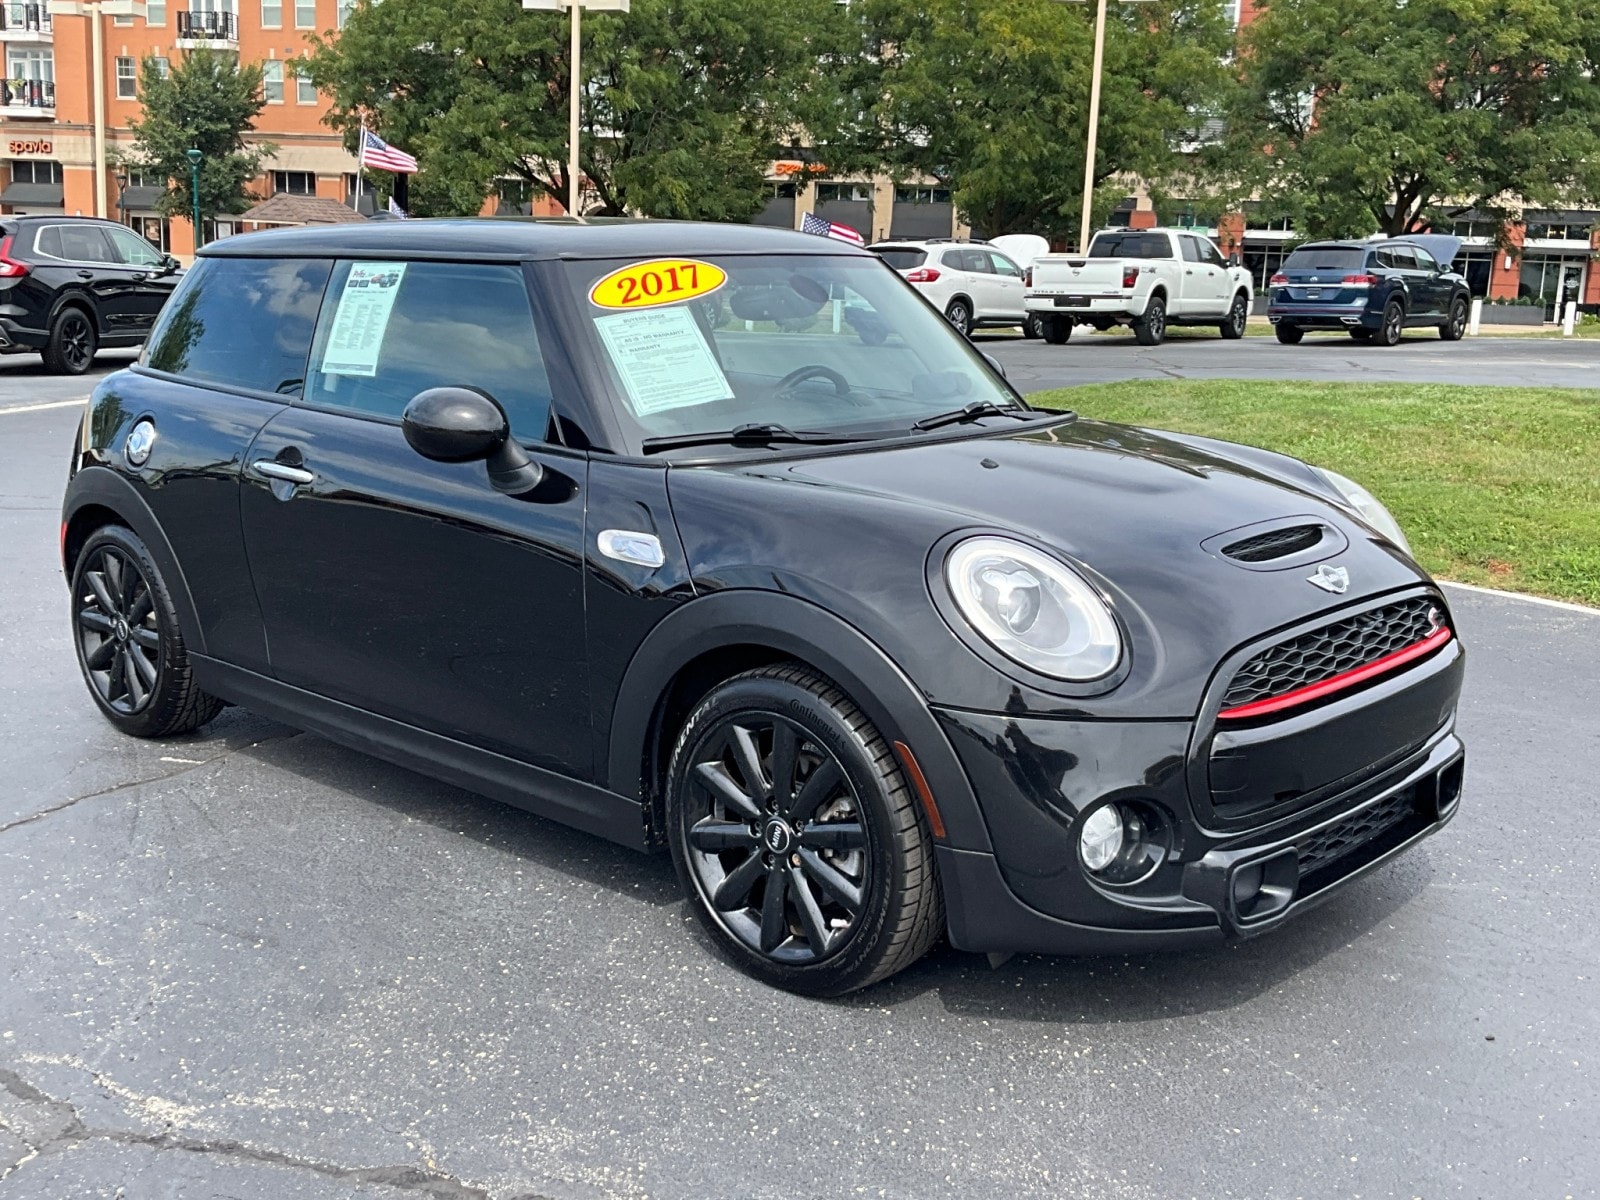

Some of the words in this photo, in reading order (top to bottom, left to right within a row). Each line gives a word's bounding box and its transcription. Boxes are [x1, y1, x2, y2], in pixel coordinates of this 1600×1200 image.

[9, 139, 53, 156] spavia
[617, 264, 698, 304] 2017
[790, 699, 841, 741] Continental
[771, 825, 782, 848] MINI
